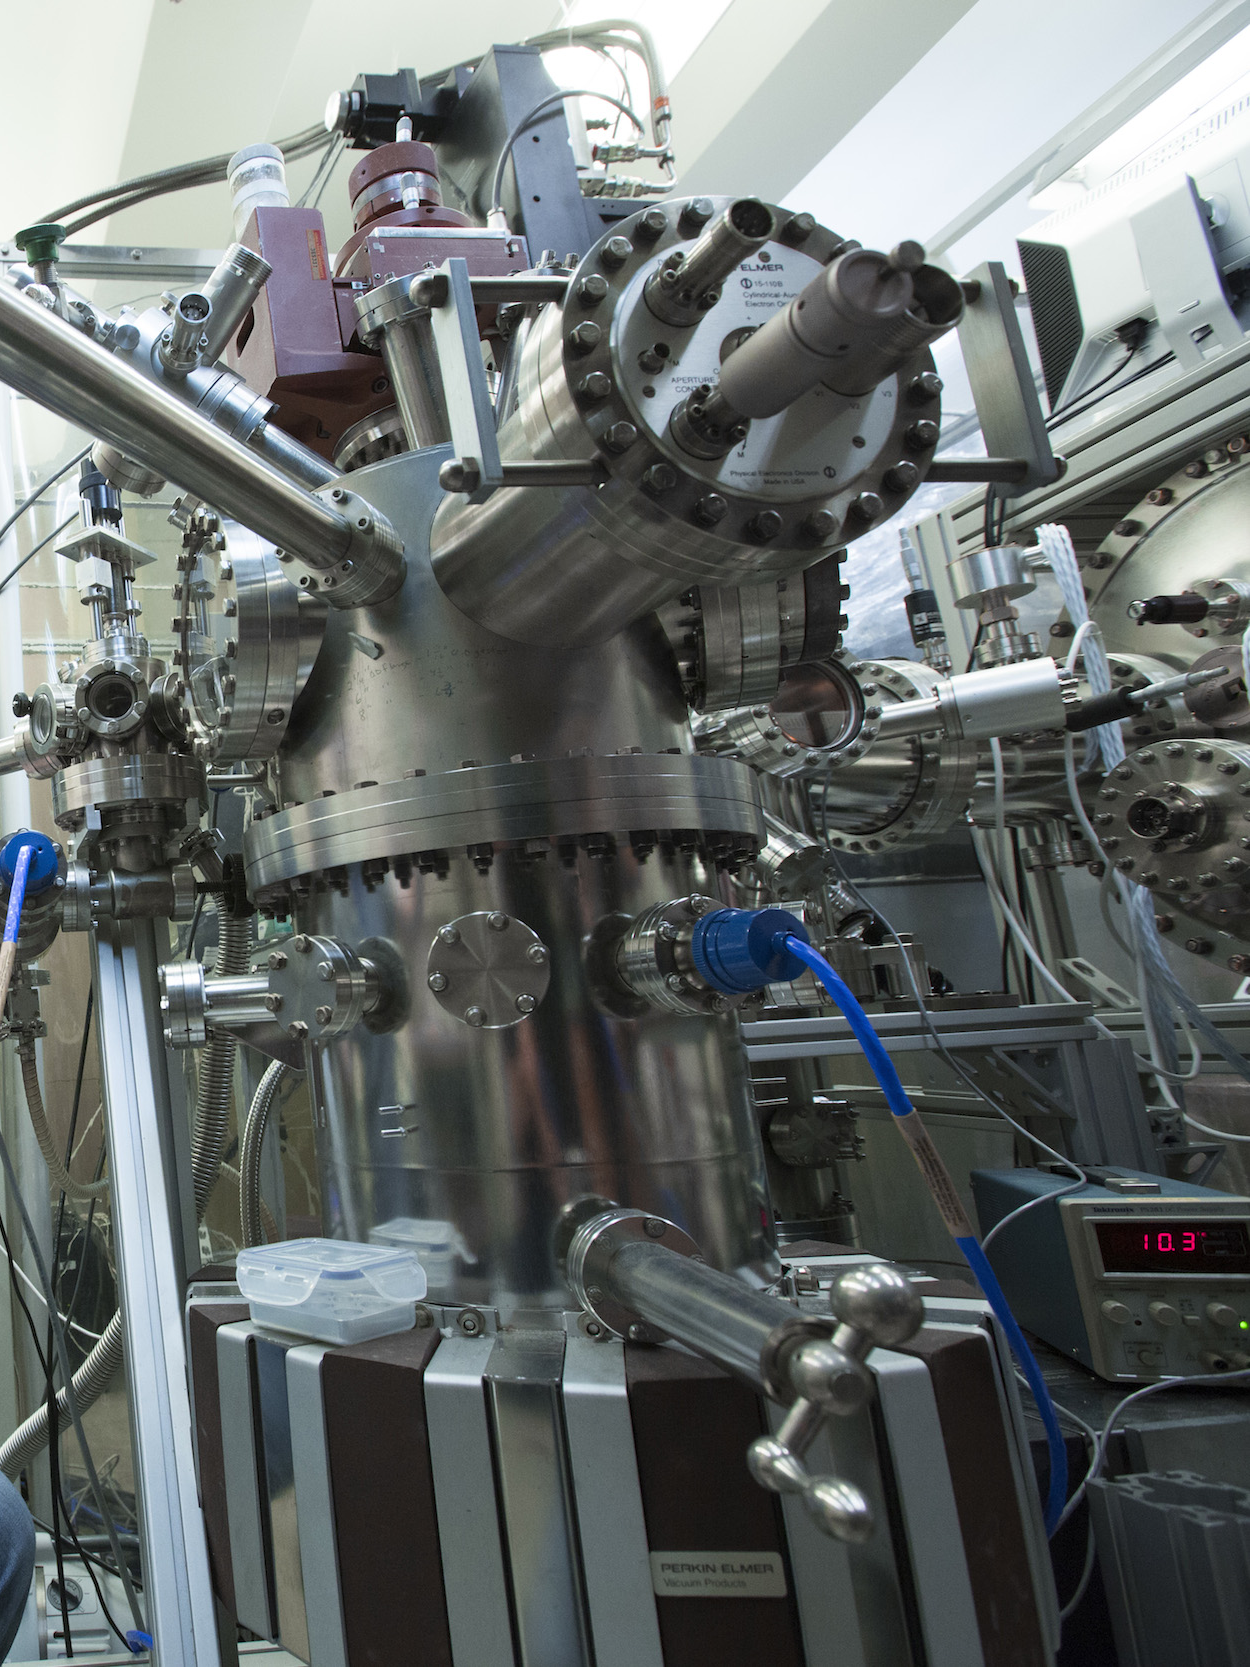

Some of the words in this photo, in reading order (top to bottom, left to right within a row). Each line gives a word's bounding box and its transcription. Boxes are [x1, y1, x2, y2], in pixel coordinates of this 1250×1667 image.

[740, 263, 784, 272] ELMER
[671, 376, 716, 384] APERTURE
[1144, 1232, 1196, 1252] 10.3
[661, 1563, 716, 1573] PERKIN
[721, 1563, 774, 1574] ELMER
[663, 1578, 702, 1587] Vacuum
[704, 1578, 747, 1588] Products
